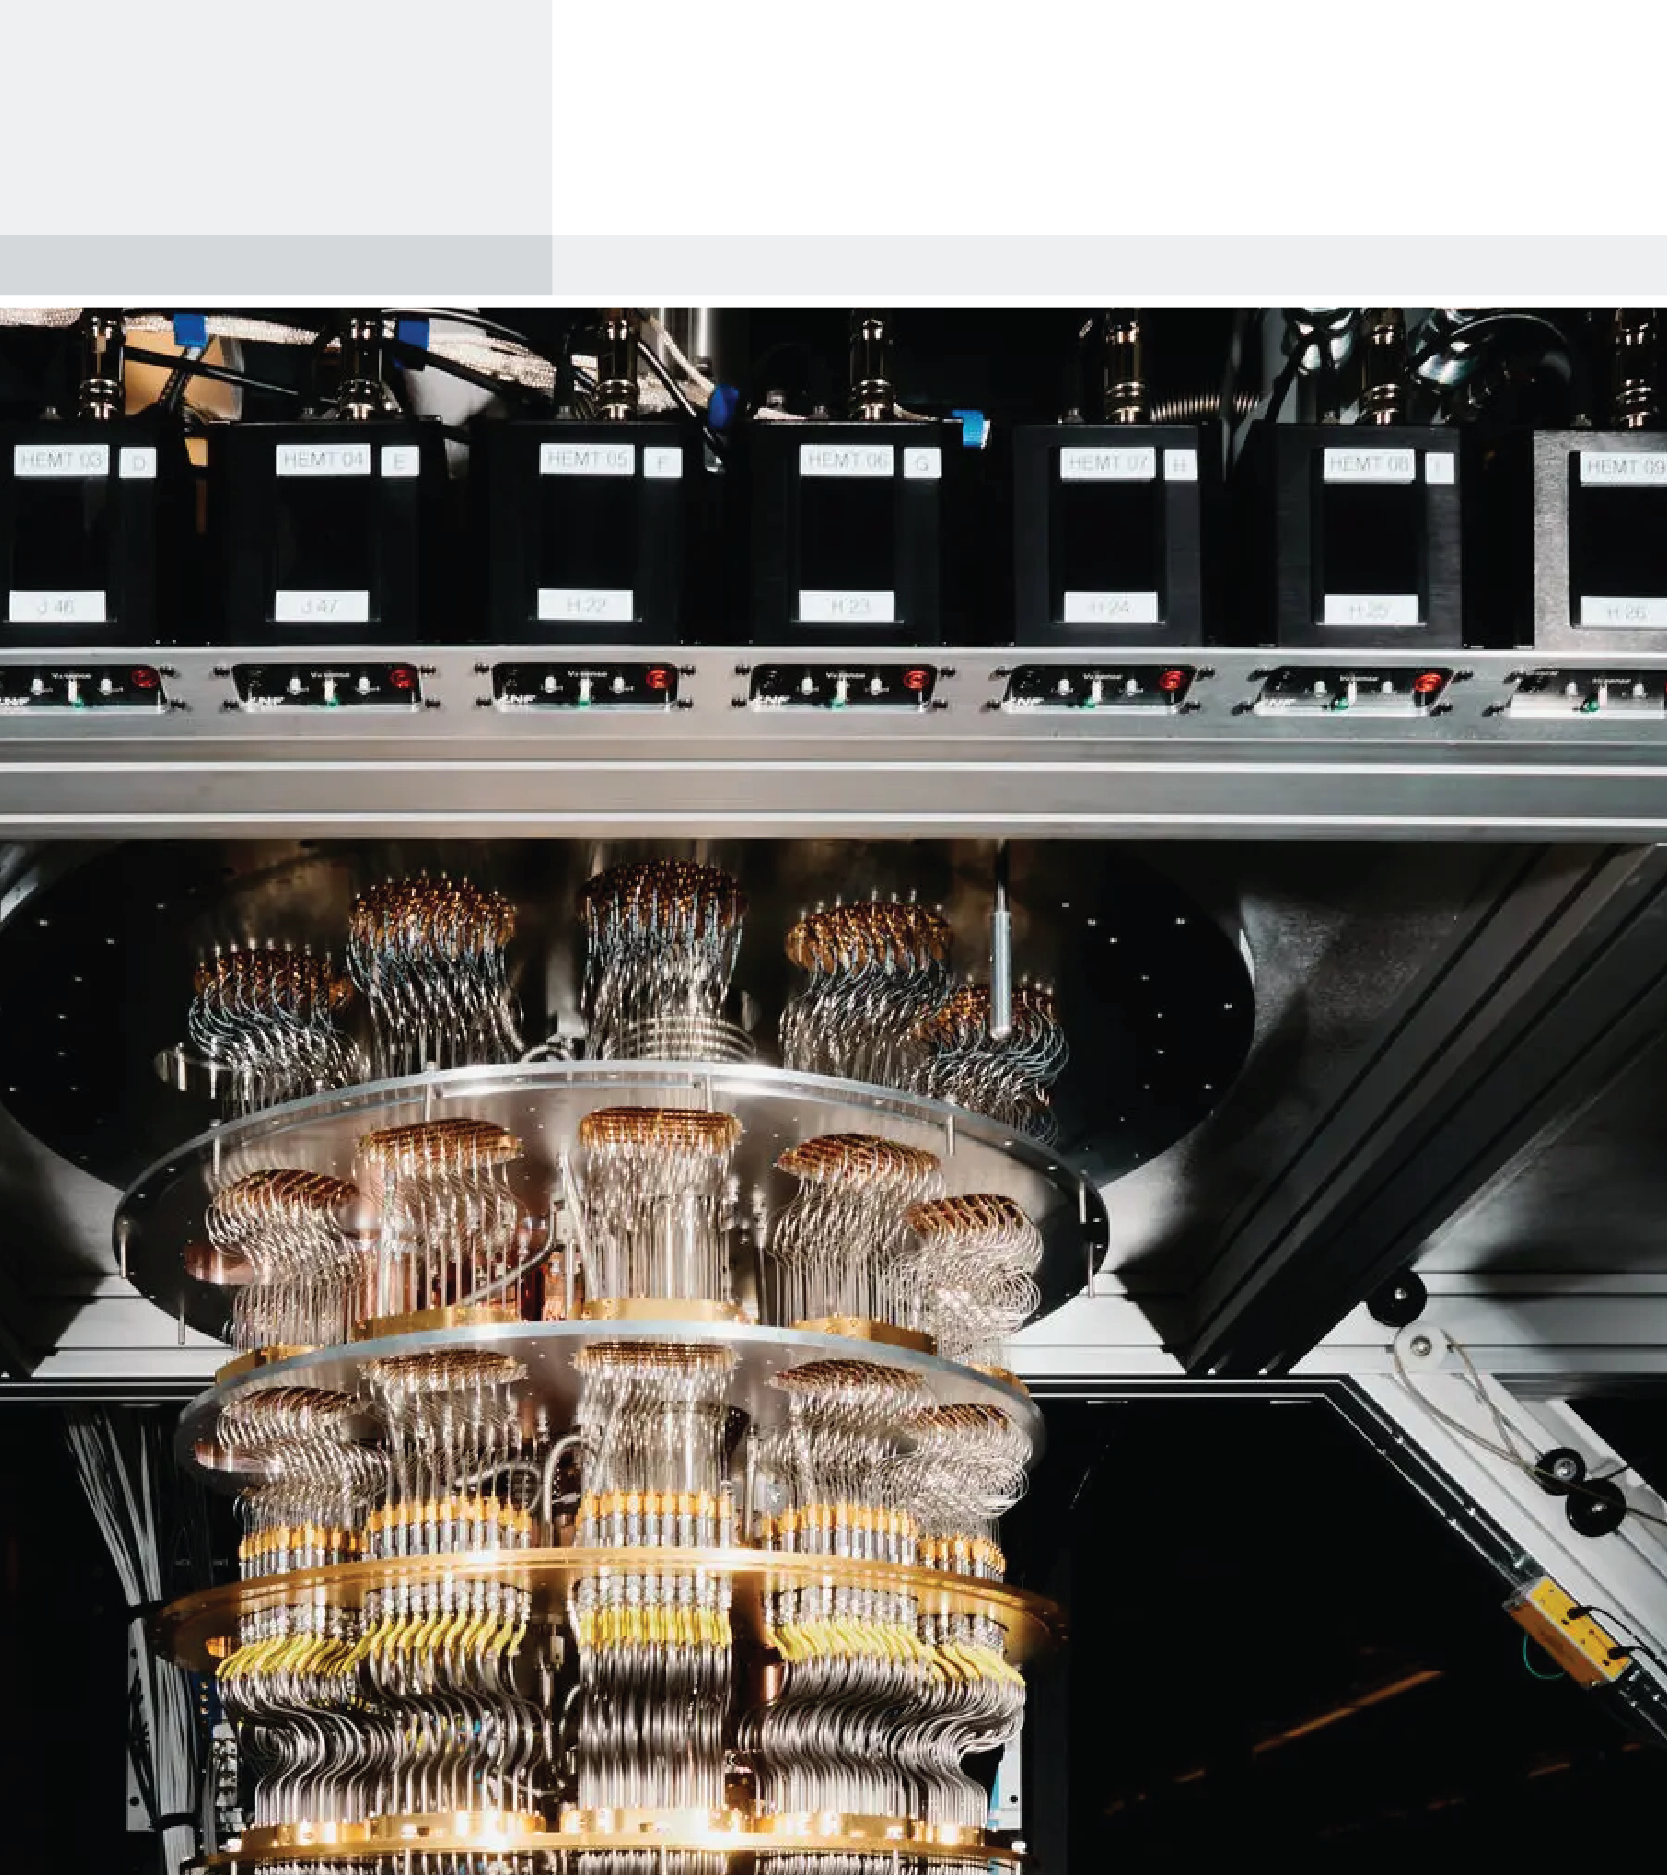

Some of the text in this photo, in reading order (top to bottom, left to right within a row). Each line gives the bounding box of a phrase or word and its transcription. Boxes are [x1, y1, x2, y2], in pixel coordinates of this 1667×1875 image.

[21, 451, 73, 468] HEMT
[133, 455, 146, 471] D
[284, 451, 338, 468] HEMT
[394, 454, 406, 470] E
[547, 451, 600, 468] HEMT
[657, 456, 669, 471] F
[808, 451, 859, 468] HEMT
[915, 455, 929, 472] G
[1068, 454, 1120, 471] HEMT
[1173, 457, 1187, 472] H
[1330, 456, 1382, 472] HEMT
[1587, 459, 1639, 475] HEMT
[37, 599, 47, 615] J
[567, 597, 580, 613] H
[830, 598, 843, 614] H
